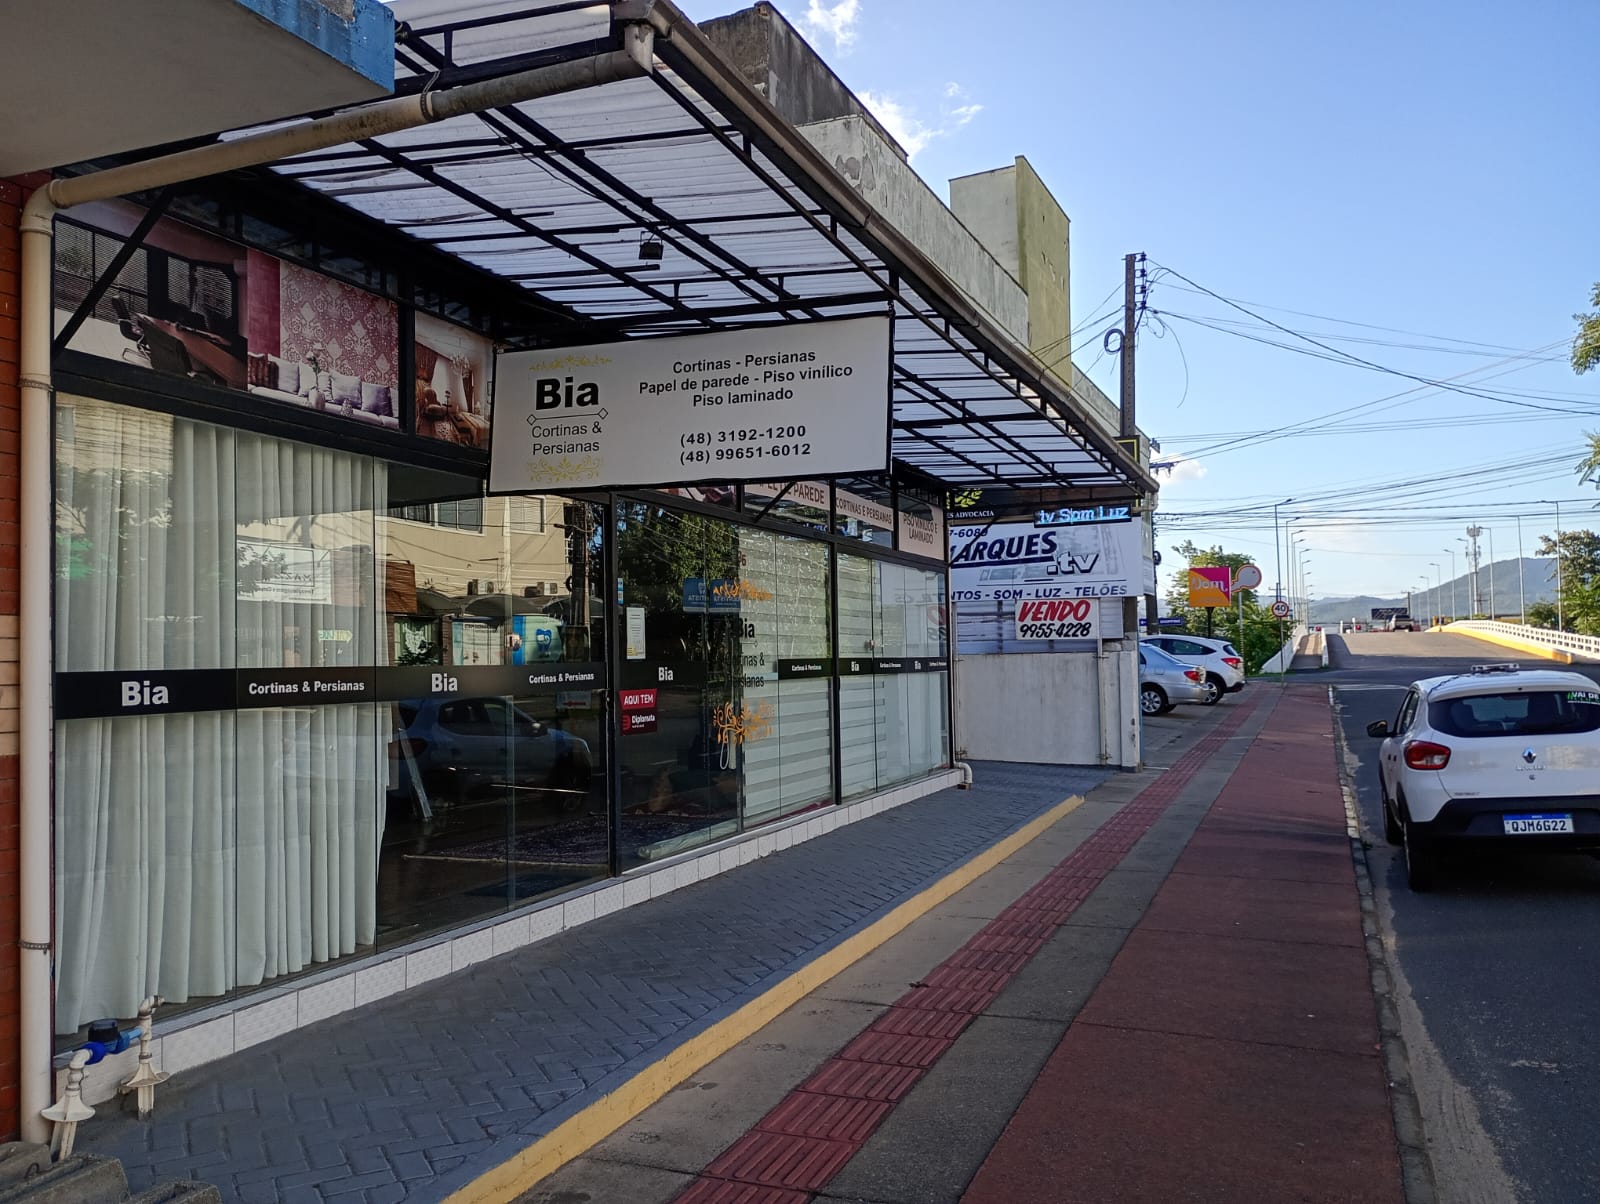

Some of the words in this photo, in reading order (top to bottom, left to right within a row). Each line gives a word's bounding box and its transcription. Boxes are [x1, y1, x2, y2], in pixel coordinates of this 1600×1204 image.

[673, 359, 731, 374] Cortinas
[745, 351, 816, 367] Persianas
[639, 379, 677, 396] Papel
[681, 378, 697, 391] de
[702, 373, 750, 392] parede
[763, 369, 795, 383] Piso
[799, 364, 853, 380] vinílico
[535, 376, 599, 410] Bia
[693, 393, 724, 407] Piso
[728, 387, 794, 404] laminado
[531, 424, 587, 438] Cortinas
[592, 421, 602, 434] &
[680, 432, 712, 448] (48)
[717, 425, 806, 442] 3192-1200
[532, 441, 600, 455] Persianas
[680, 450, 711, 466] (48)
[715, 443, 811, 460] 99651-6012
[793, 483, 825, 504] PAREDE
[955, 510, 995, 518] ADVOCACIA
[1060, 508, 1094, 523] Som
[1100, 505, 1129, 519] Luz
[951, 531, 1058, 563] ARQUES
[993, 589, 1023, 600] SOM
[1035, 588, 1062, 598] LUZ
[1074, 584, 1127, 596] TELÕES
[1018, 600, 1091, 622] VENDO
[1274, 604, 1286, 612] 40
[1020, 622, 1092, 638] 9955-4228
[431, 673, 458, 692] Bia
[529, 675, 557, 684] Cortinas
[558, 674, 563, 682] &
[564, 673, 594, 681] Persianas
[658, 666, 674, 681] Bia
[121, 680, 169, 707] Bia
[249, 682, 299, 695] Cortinas
[302, 681, 311, 692] &
[314, 680, 365, 692] Persianas
[624, 695, 640, 705] AQUI
[640, 694, 654, 704] TEM
